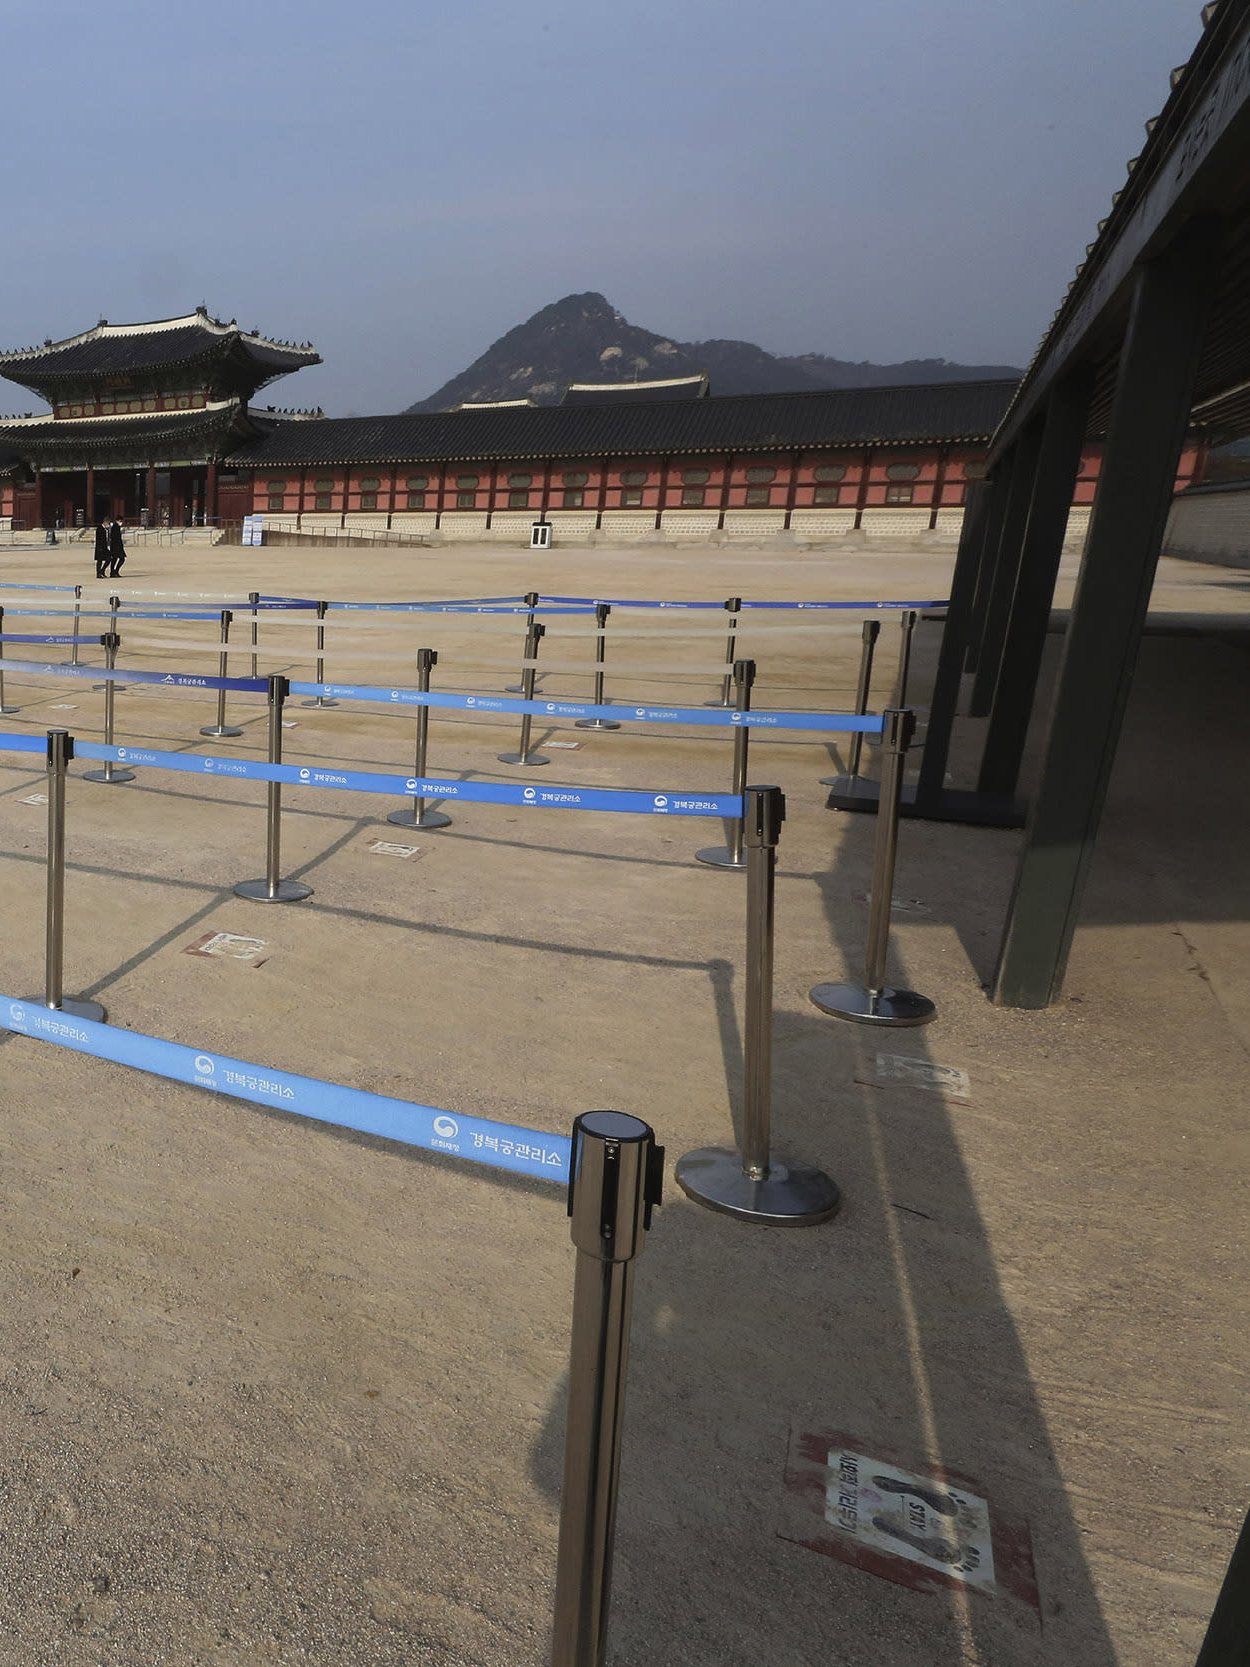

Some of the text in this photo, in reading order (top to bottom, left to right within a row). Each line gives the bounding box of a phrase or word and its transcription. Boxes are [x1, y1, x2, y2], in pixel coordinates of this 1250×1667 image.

[672, 800, 719, 810] 경복궁관리소
[223, 1069, 295, 1100] 경복궁관리소
[430, 1138, 461, 1153] 문화재청
[469, 1131, 563, 1167] 경복궁관리소
[909, 1502, 926, 1532] STAY
